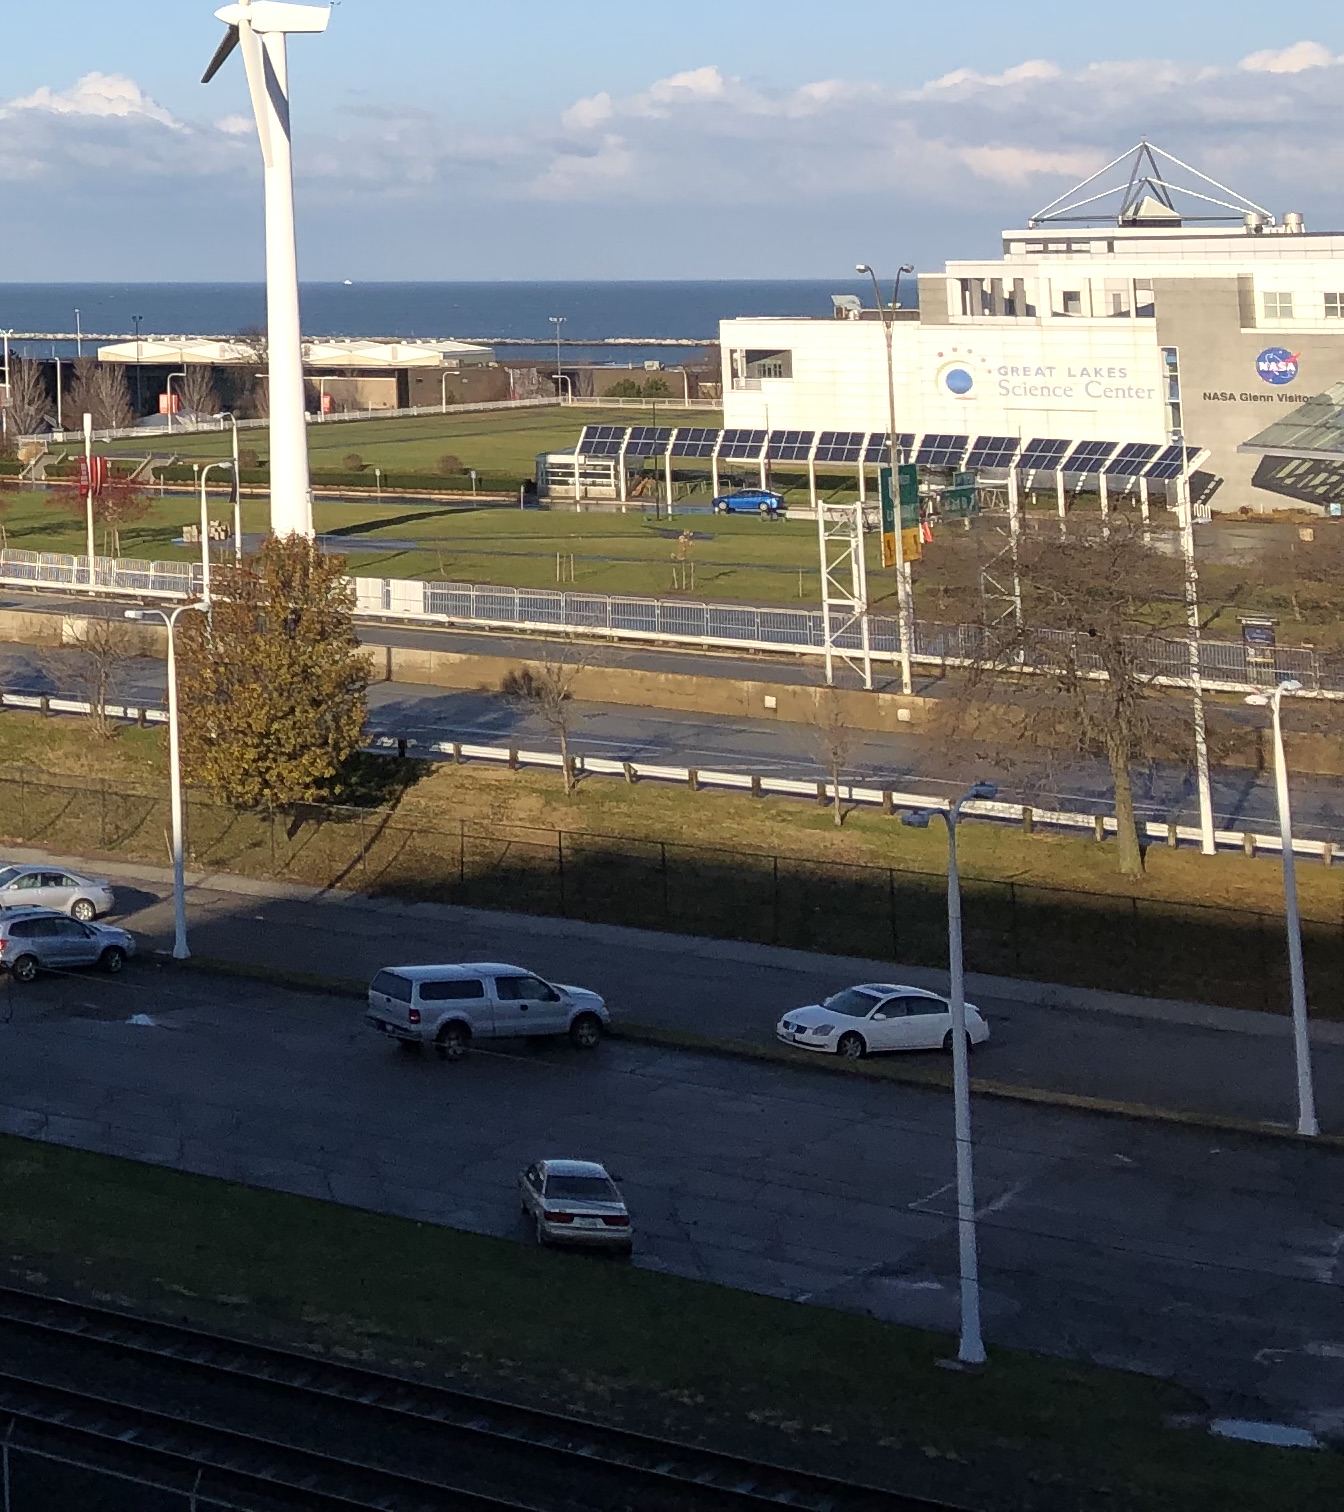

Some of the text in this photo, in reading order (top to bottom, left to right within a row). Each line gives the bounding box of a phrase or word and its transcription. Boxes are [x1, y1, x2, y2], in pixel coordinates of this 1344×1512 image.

[998, 366, 1128, 378] GREAT LAKES
[1259, 361, 1296, 372] NASA
[998, 379, 1155, 399] Science Center
[1203, 392, 1237, 402] NASA
[1240, 392, 1274, 402] Glenn
